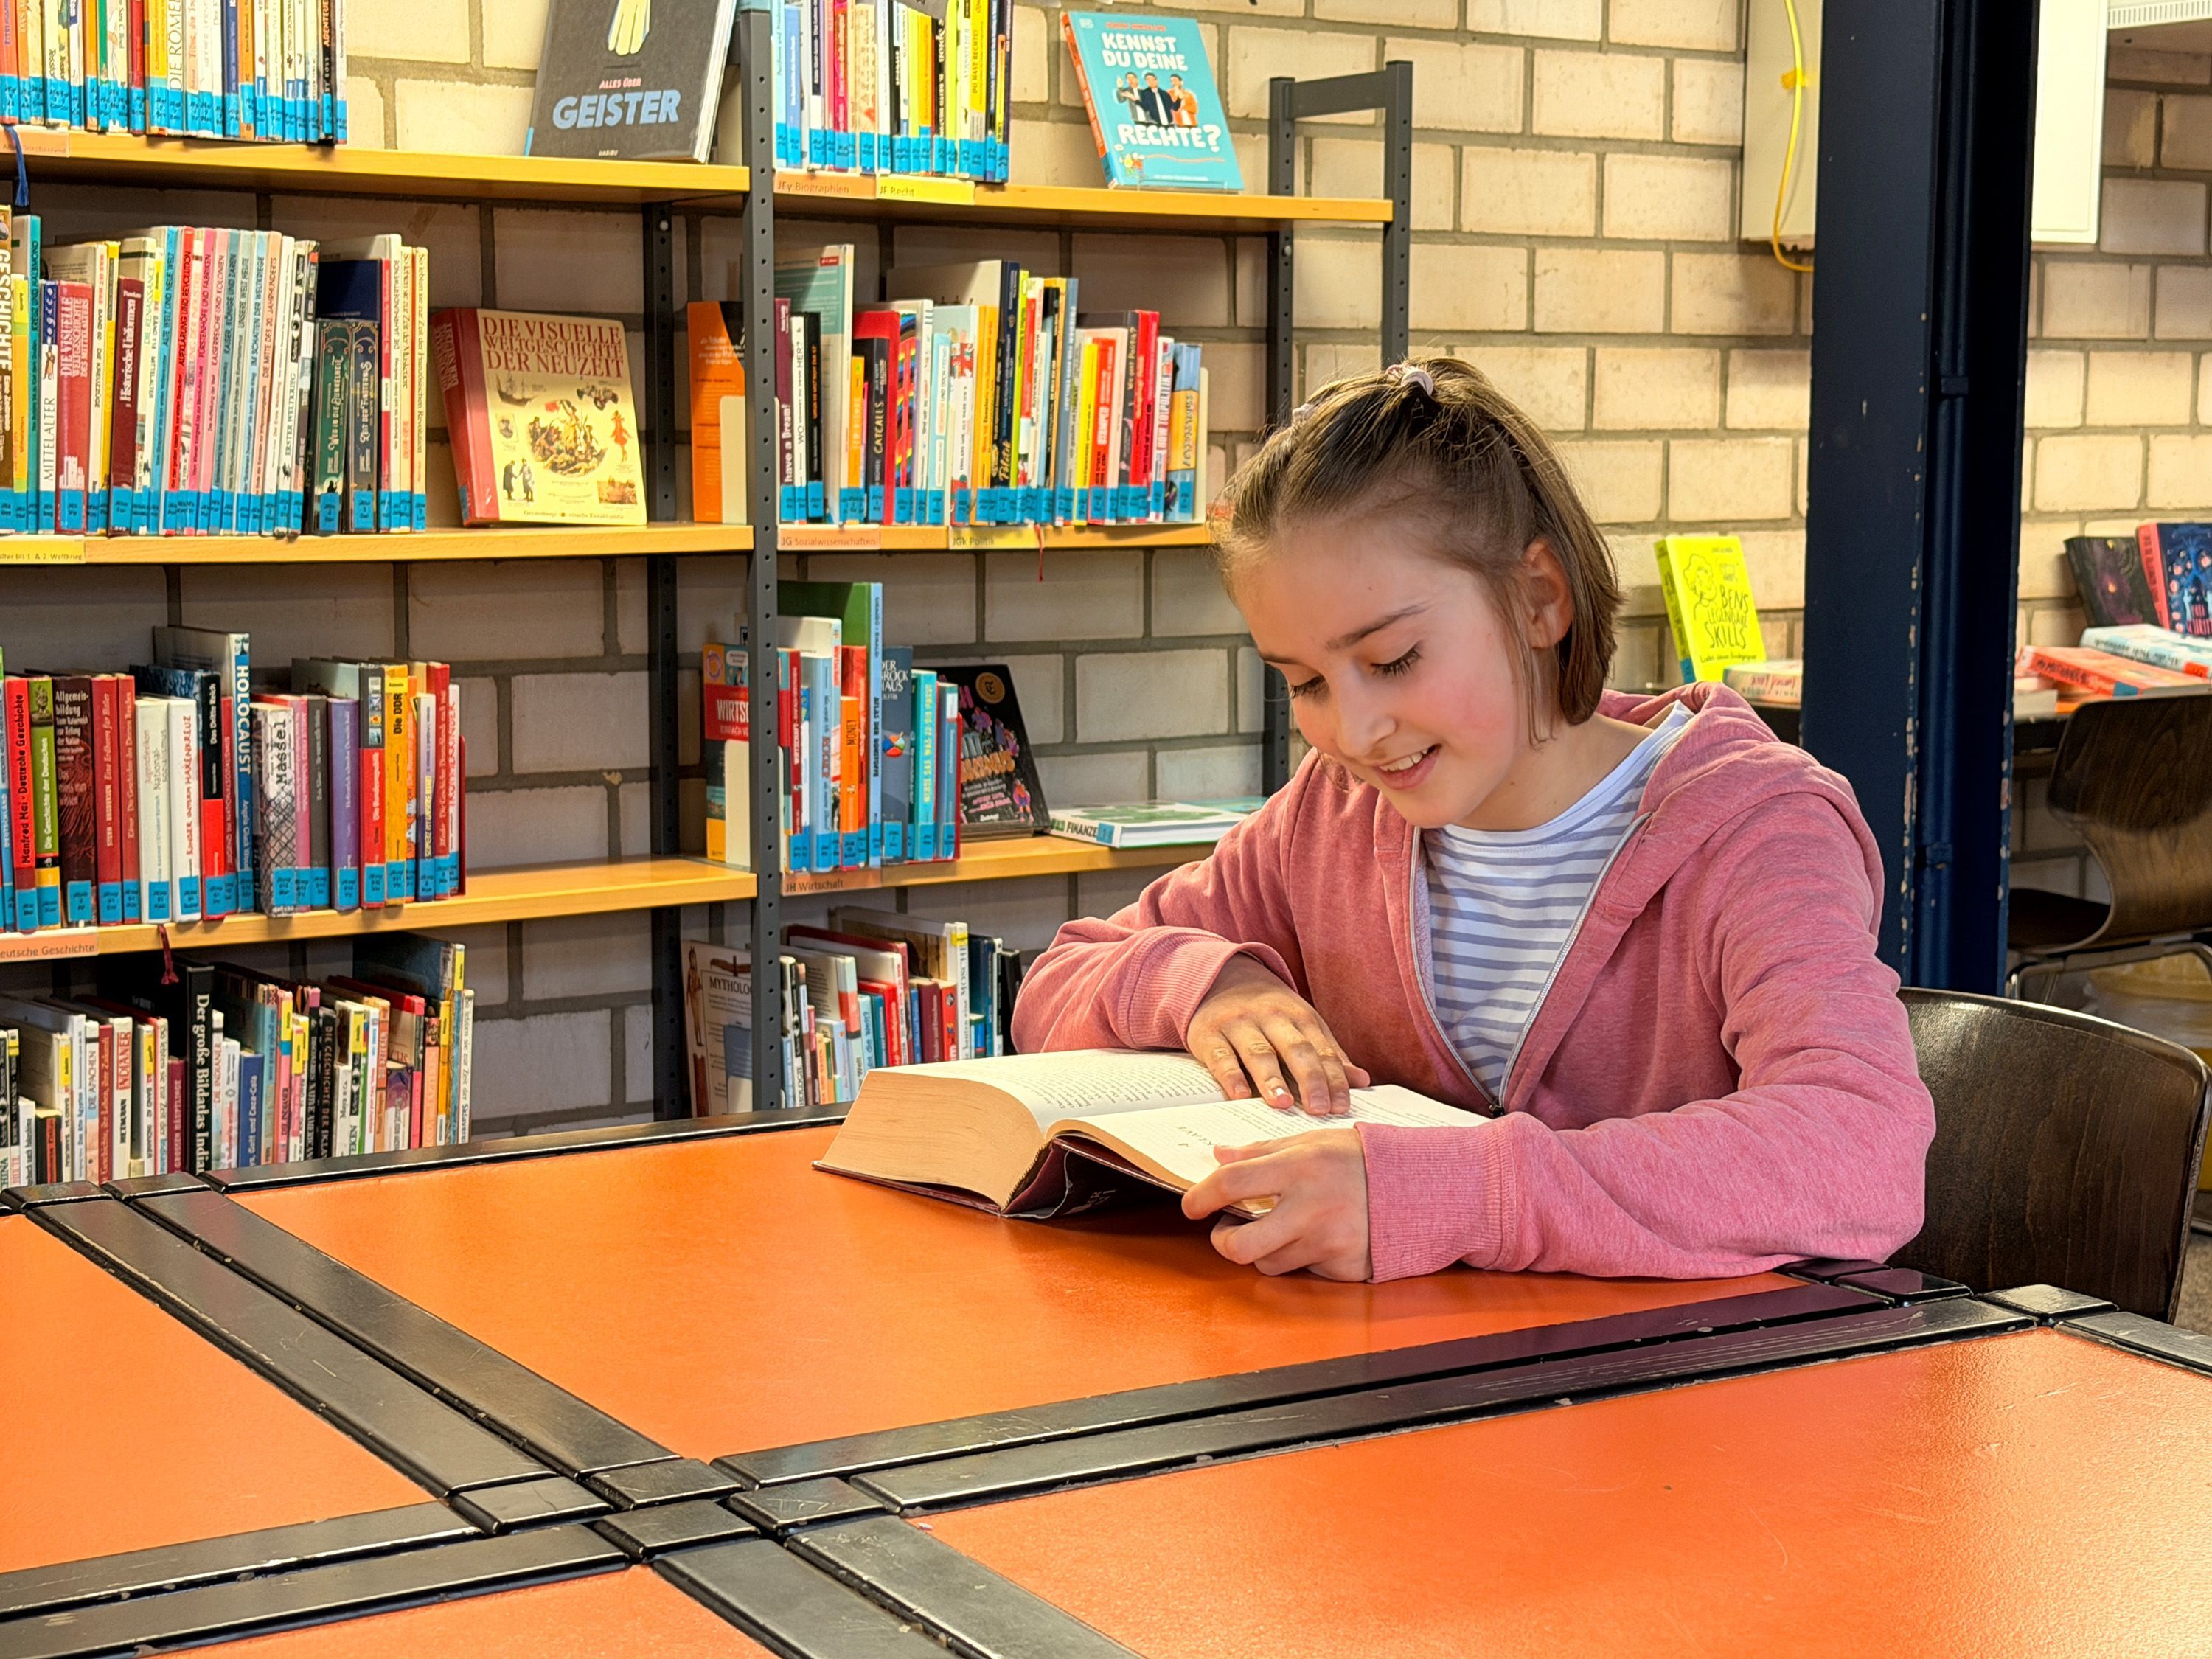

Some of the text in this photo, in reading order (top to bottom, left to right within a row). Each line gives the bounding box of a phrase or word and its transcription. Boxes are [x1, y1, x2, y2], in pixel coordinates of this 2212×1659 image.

[1101, 32, 1177, 53] KENNST
[1102, 49, 1189, 72] DU DEINE
[169, 63, 182, 90] DIE
[599, 77, 642, 89] ALLES ÜBER
[553, 89, 682, 130] GEISTER
[1117, 124, 1222, 153] RECHTE?
[890, 187, 914, 196] Recht
[182, 251, 191, 296] REVOLUTION
[241, 257, 249, 279] HEUTE
[255, 256, 264, 299] WELTKRIEGE
[145, 265, 155, 326] RENAISSANCE
[198, 254, 212, 357] FÜRSTENHÖFE UND FABRIKEN
[212, 255, 224, 365] KAISERREICHE UND KOLONIEN
[238, 301, 247, 328] UNSERE
[60, 297, 73, 376] DIE VISUELLE
[72, 298, 82, 377] WELTGESCHICHTE
[80, 298, 89, 359] MITTELALTERS
[178, 316, 188, 366] AUFKLÄRUNG
[251, 318, 260, 355] SCHATTEN
[482, 317, 622, 345] DIE VISUELLE
[484, 335, 623, 359] WELTGESCHICHTE
[120, 299, 136, 401] Historische Uniformen
[251, 357, 257, 366] IM
[487, 350, 624, 378] DER NEUZEIT
[796, 341, 804, 368] HER?
[288, 373, 296, 422] WELTKRIEG
[44, 397, 55, 481] MITTELALTER
[781, 404, 793, 482] have a Dream!
[874, 401, 884, 453] CATCALLS
[999, 439, 1011, 481] Politik
[782, 536, 876, 546] JG Sozialwissenschaften
[970, 536, 994, 546] Politik
[1719, 585, 1749, 613] BENS
[1704, 622, 1747, 650] SKILLS
[55, 689, 89, 703] Allgemein-
[55, 703, 81, 717] bildung
[209, 683, 218, 745] Das Dritte Reich
[392, 693, 403, 734] Die DDR
[237, 664, 251, 774] HOLOCAUST
[846, 720, 857, 745] MONEY
[183, 714, 192, 785] HAKENKREUZ
[274, 718, 288, 787] Massel
[14, 694, 31, 863] Manfred Mai Deutsche Geschichte
[105, 763, 113, 781] Eine
[41, 737, 53, 849] Die Geschichte der Deutschen
[785, 877, 844, 892] JH Wirtschaft
[0, 943, 95, 959] eutsche Geschichte
[161, 1029, 167, 1040] So
[324, 1026, 333, 1043] DIE
[116, 1032, 131, 1091] INDIANER
[192, 994, 210, 1130] Der große Bildatlas
[213, 1043, 221, 1103] DIE INDIANER
[323, 1046, 332, 1105] GESCHICHTE
[248, 1075, 258, 1153] Gott und Coca-Cola
[340, 1098, 348, 1118] Maya
